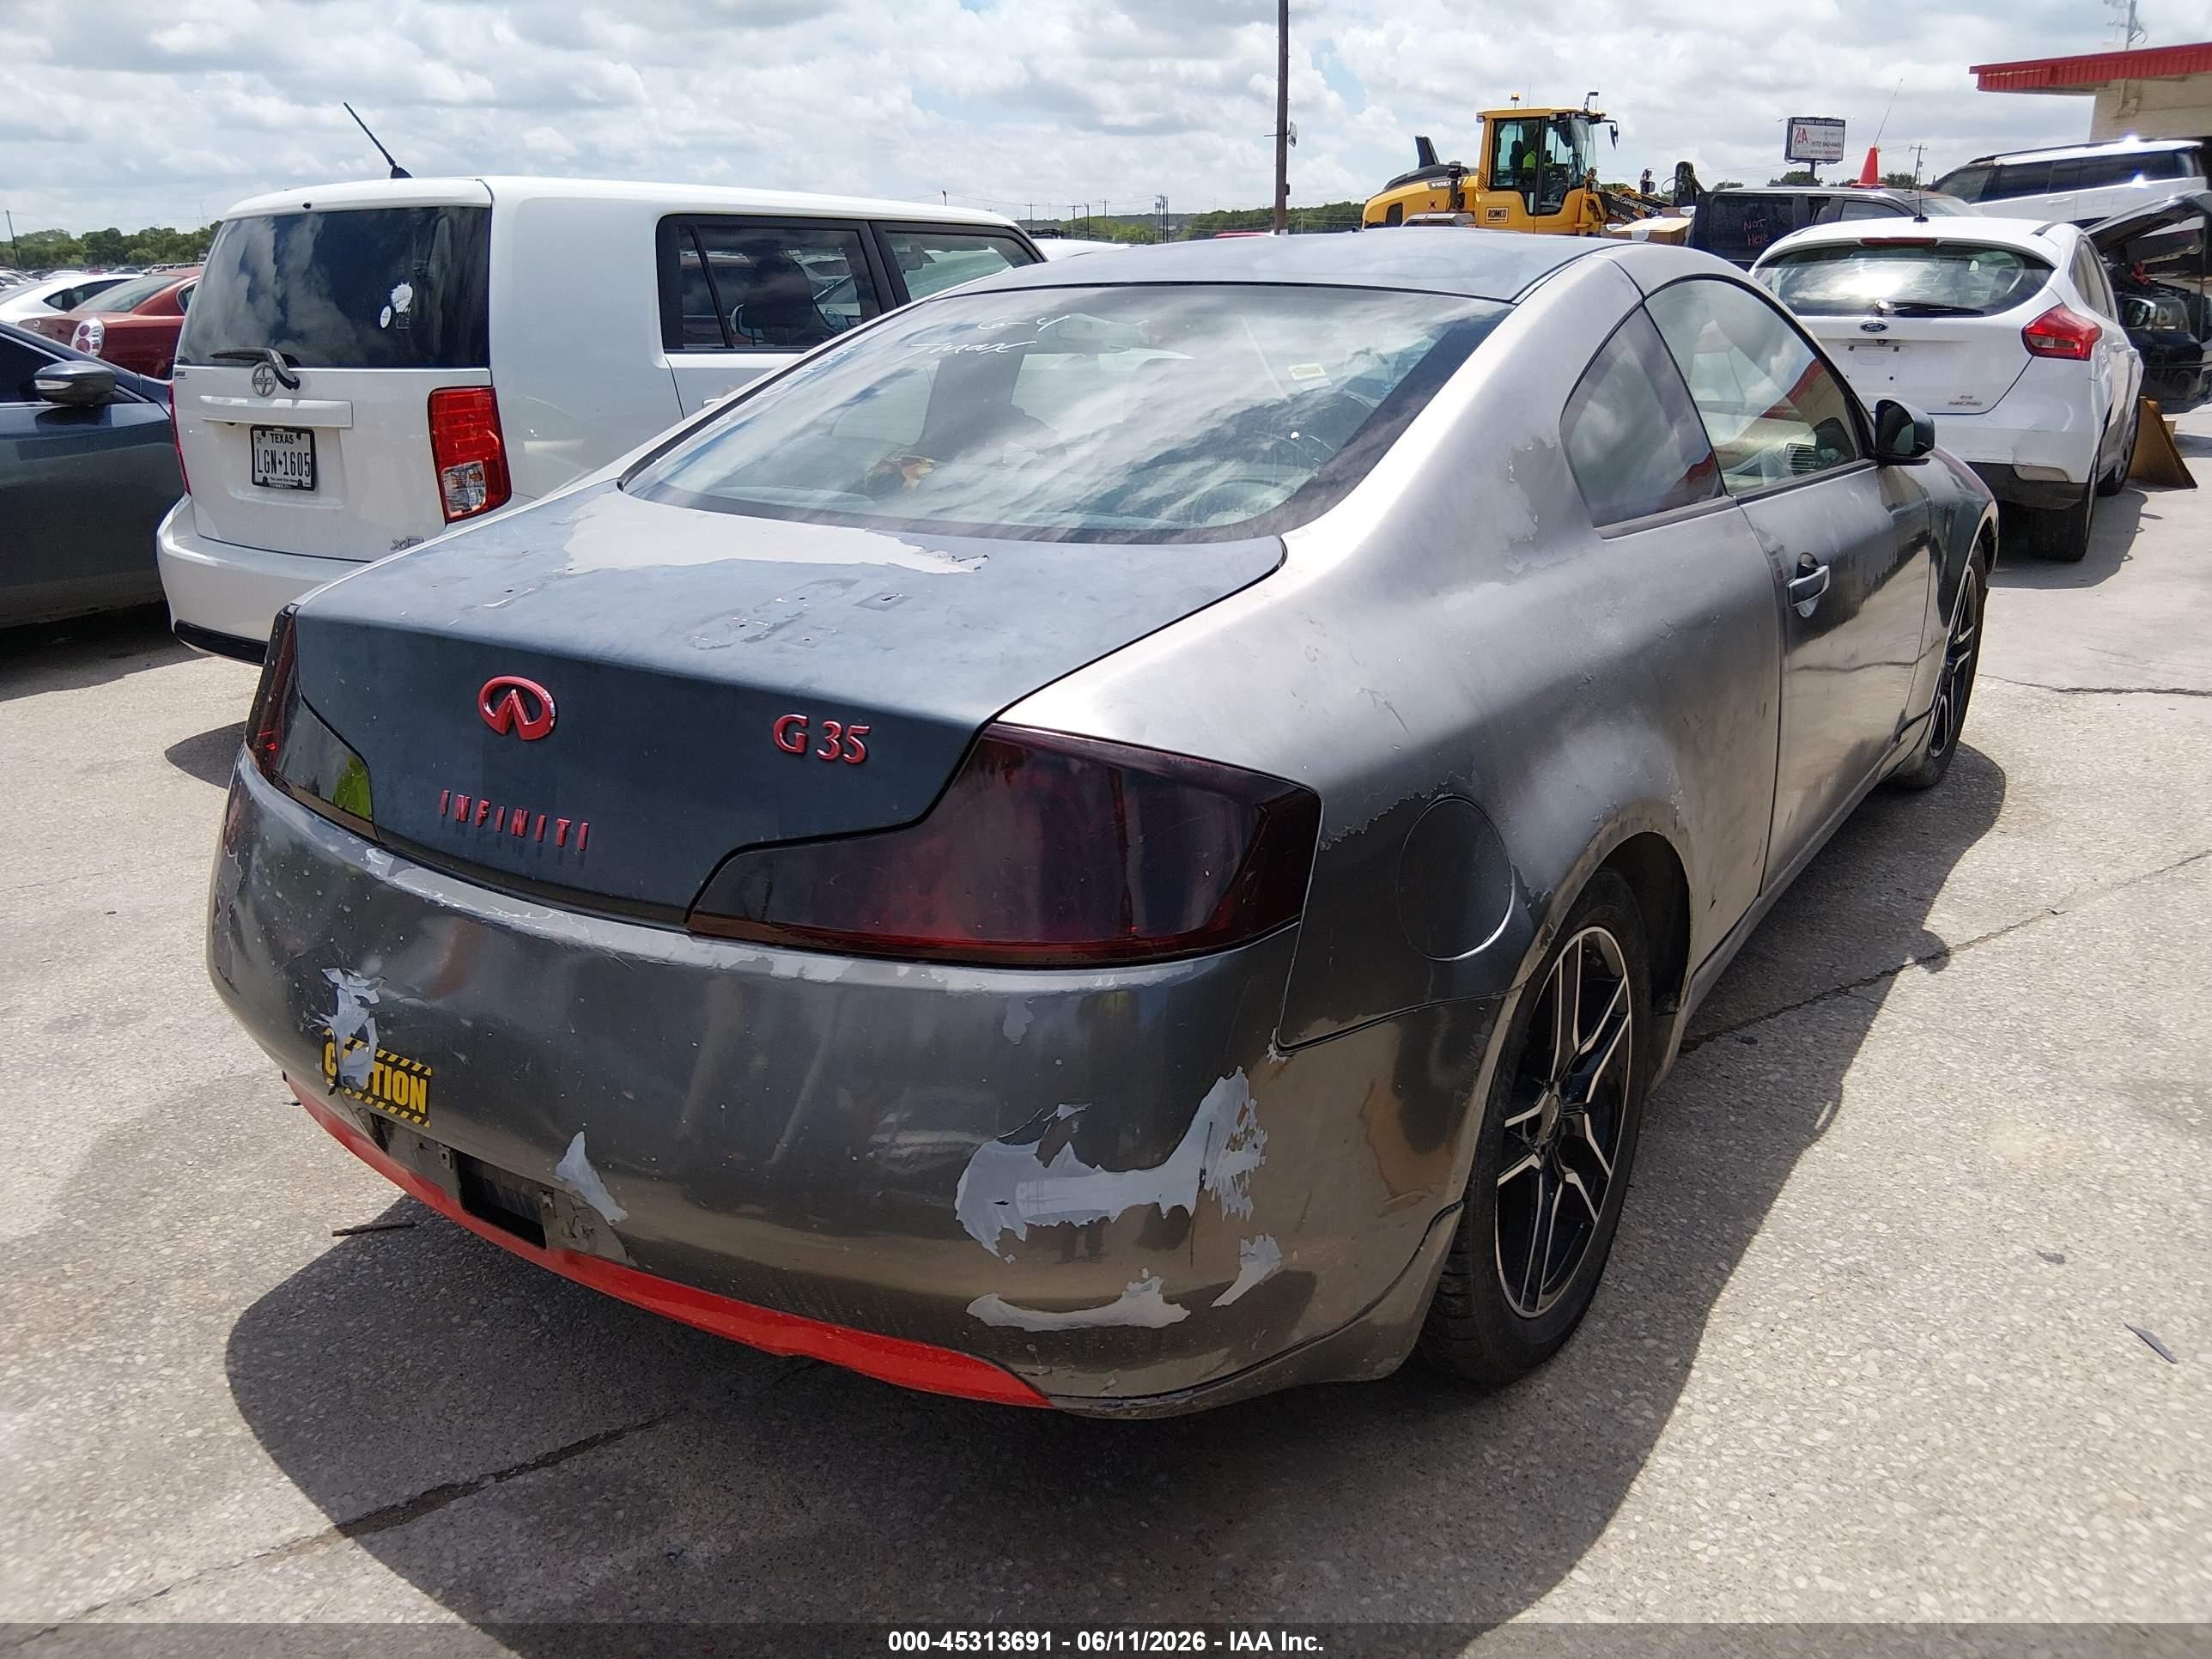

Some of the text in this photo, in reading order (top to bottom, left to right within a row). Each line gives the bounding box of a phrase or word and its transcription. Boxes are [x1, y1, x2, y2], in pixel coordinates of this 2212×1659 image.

[270, 433, 295, 445] TEXAS
[440, 789, 590, 851] INFINITI
[325, 1042, 428, 1115] CTION
